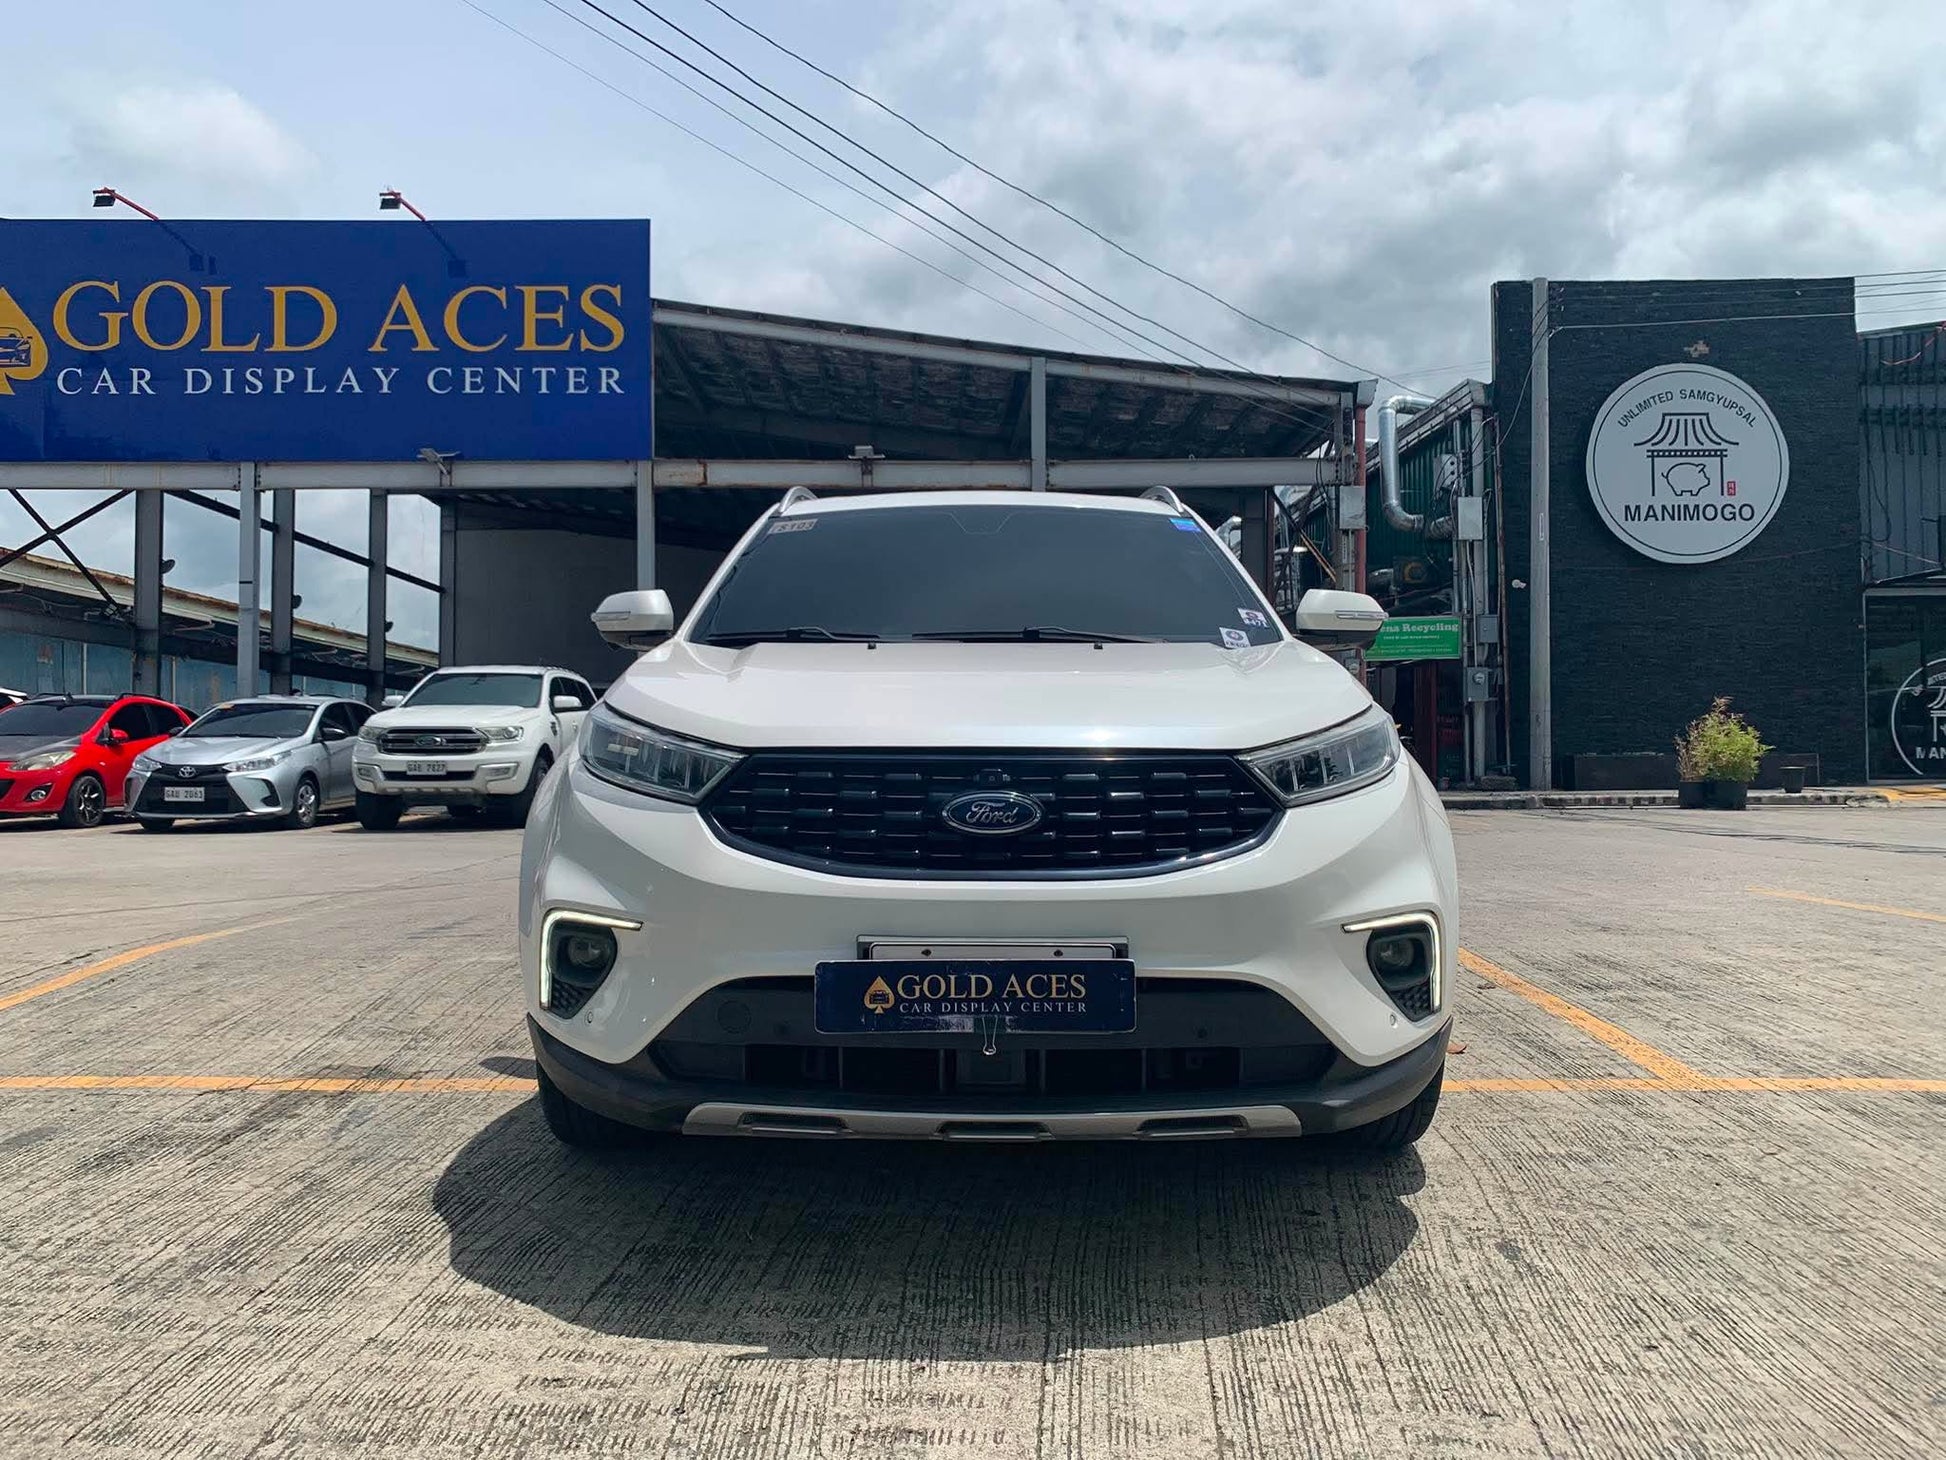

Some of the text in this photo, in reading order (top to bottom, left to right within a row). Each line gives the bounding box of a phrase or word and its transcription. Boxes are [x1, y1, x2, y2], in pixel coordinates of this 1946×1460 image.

[52, 280, 625, 353] GOLD ACES
[56, 367, 625, 395] CAR DISPLAY CENTER
[1617, 388, 1757, 428] UNLIMITED SAMGYUPSAL
[1624, 503, 1755, 522] MANIMOGO
[1402, 623, 1459, 633] Recycling
[965, 801, 1019, 824] Ford
[897, 974, 1087, 1000] GOLD ACES
[899, 1002, 1087, 1014] CAR DISPLAY CENTER
